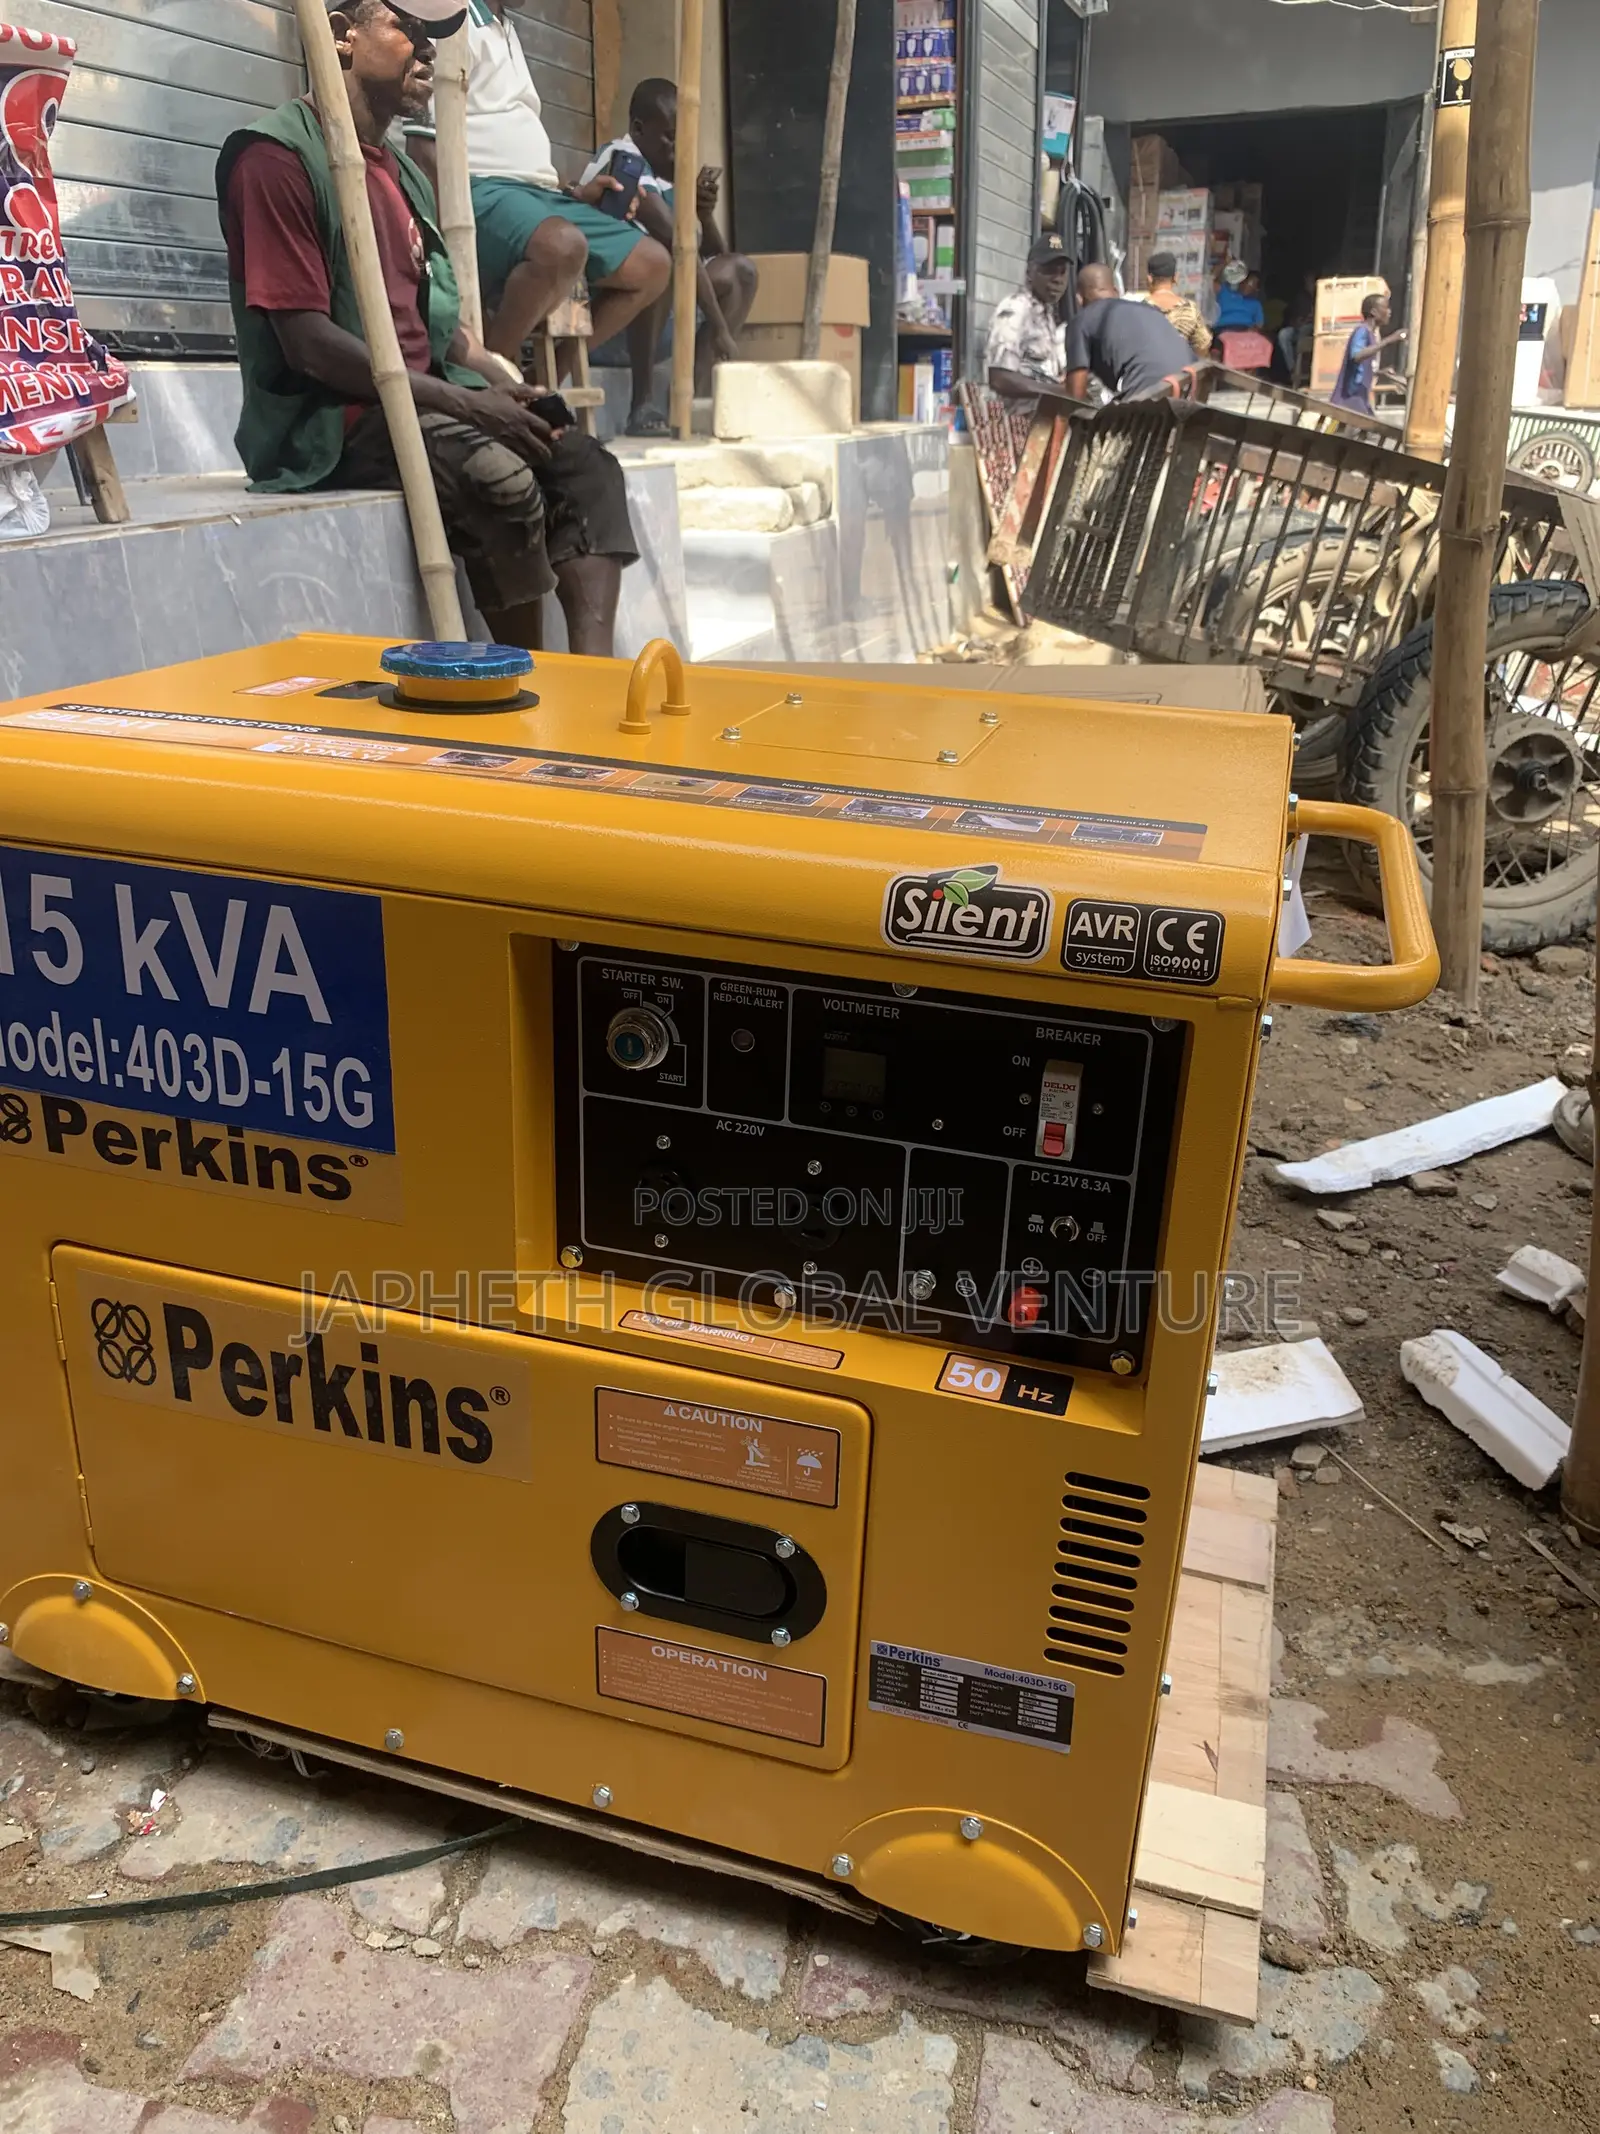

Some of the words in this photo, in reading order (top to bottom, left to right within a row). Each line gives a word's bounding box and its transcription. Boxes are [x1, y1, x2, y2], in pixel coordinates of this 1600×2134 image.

[26, 711, 170, 729] SILENT
[62, 704, 165, 718] STARTING
[165, 714, 321, 733] INSTRUCTIONS
[848, 790, 885, 798] starting
[886, 795, 935, 804] generator
[1059, 813, 1094, 821] proper
[895, 888, 1039, 943] Silent
[1071, 911, 1135, 942] AVR
[1157, 917, 1209, 954] CE
[115, 883, 333, 1025] kVA
[1076, 950, 1125, 967] system
[1150, 954, 1209, 972] ISO9001
[602, 968, 656, 986] STARTER
[661, 976, 684, 990] SW.
[623, 991, 638, 1000] OFF
[657, 996, 669, 1004] ON
[720, 982, 777, 998] GREEN-RUN
[713, 992, 752, 1006] RED-OIL
[753, 998, 784, 1010] ALERT
[822, 998, 900, 1019] VOLTMETER
[1036, 1027, 1101, 1046] BREAKER
[0, 1011, 374, 1129] odel:403D-15G
[1012, 1055, 1031, 1067] ON
[659, 1072, 683, 1082] START
[1044, 1081, 1076, 1091] DELIXI
[716, 1119, 733, 1132] AC
[735, 1121, 765, 1137] 220V
[1003, 1126, 1026, 1138] OFF
[1031, 1170, 1050, 1184] DC
[1053, 1174, 1078, 1188] 12V
[1081, 1178, 1111, 1193] 8.3A
[1028, 1223, 1043, 1234] ON
[1086, 1233, 1107, 1243] OFF
[688, 1323, 756, 1344] WARNING!
[946, 1361, 1001, 1393] 50
[678, 1406, 763, 1433] CAUTION
[651, 1645, 768, 1682] OPERATION
[889, 1645, 941, 1667] Perkins
[984, 1668, 1067, 1693] Model:403D-15G
